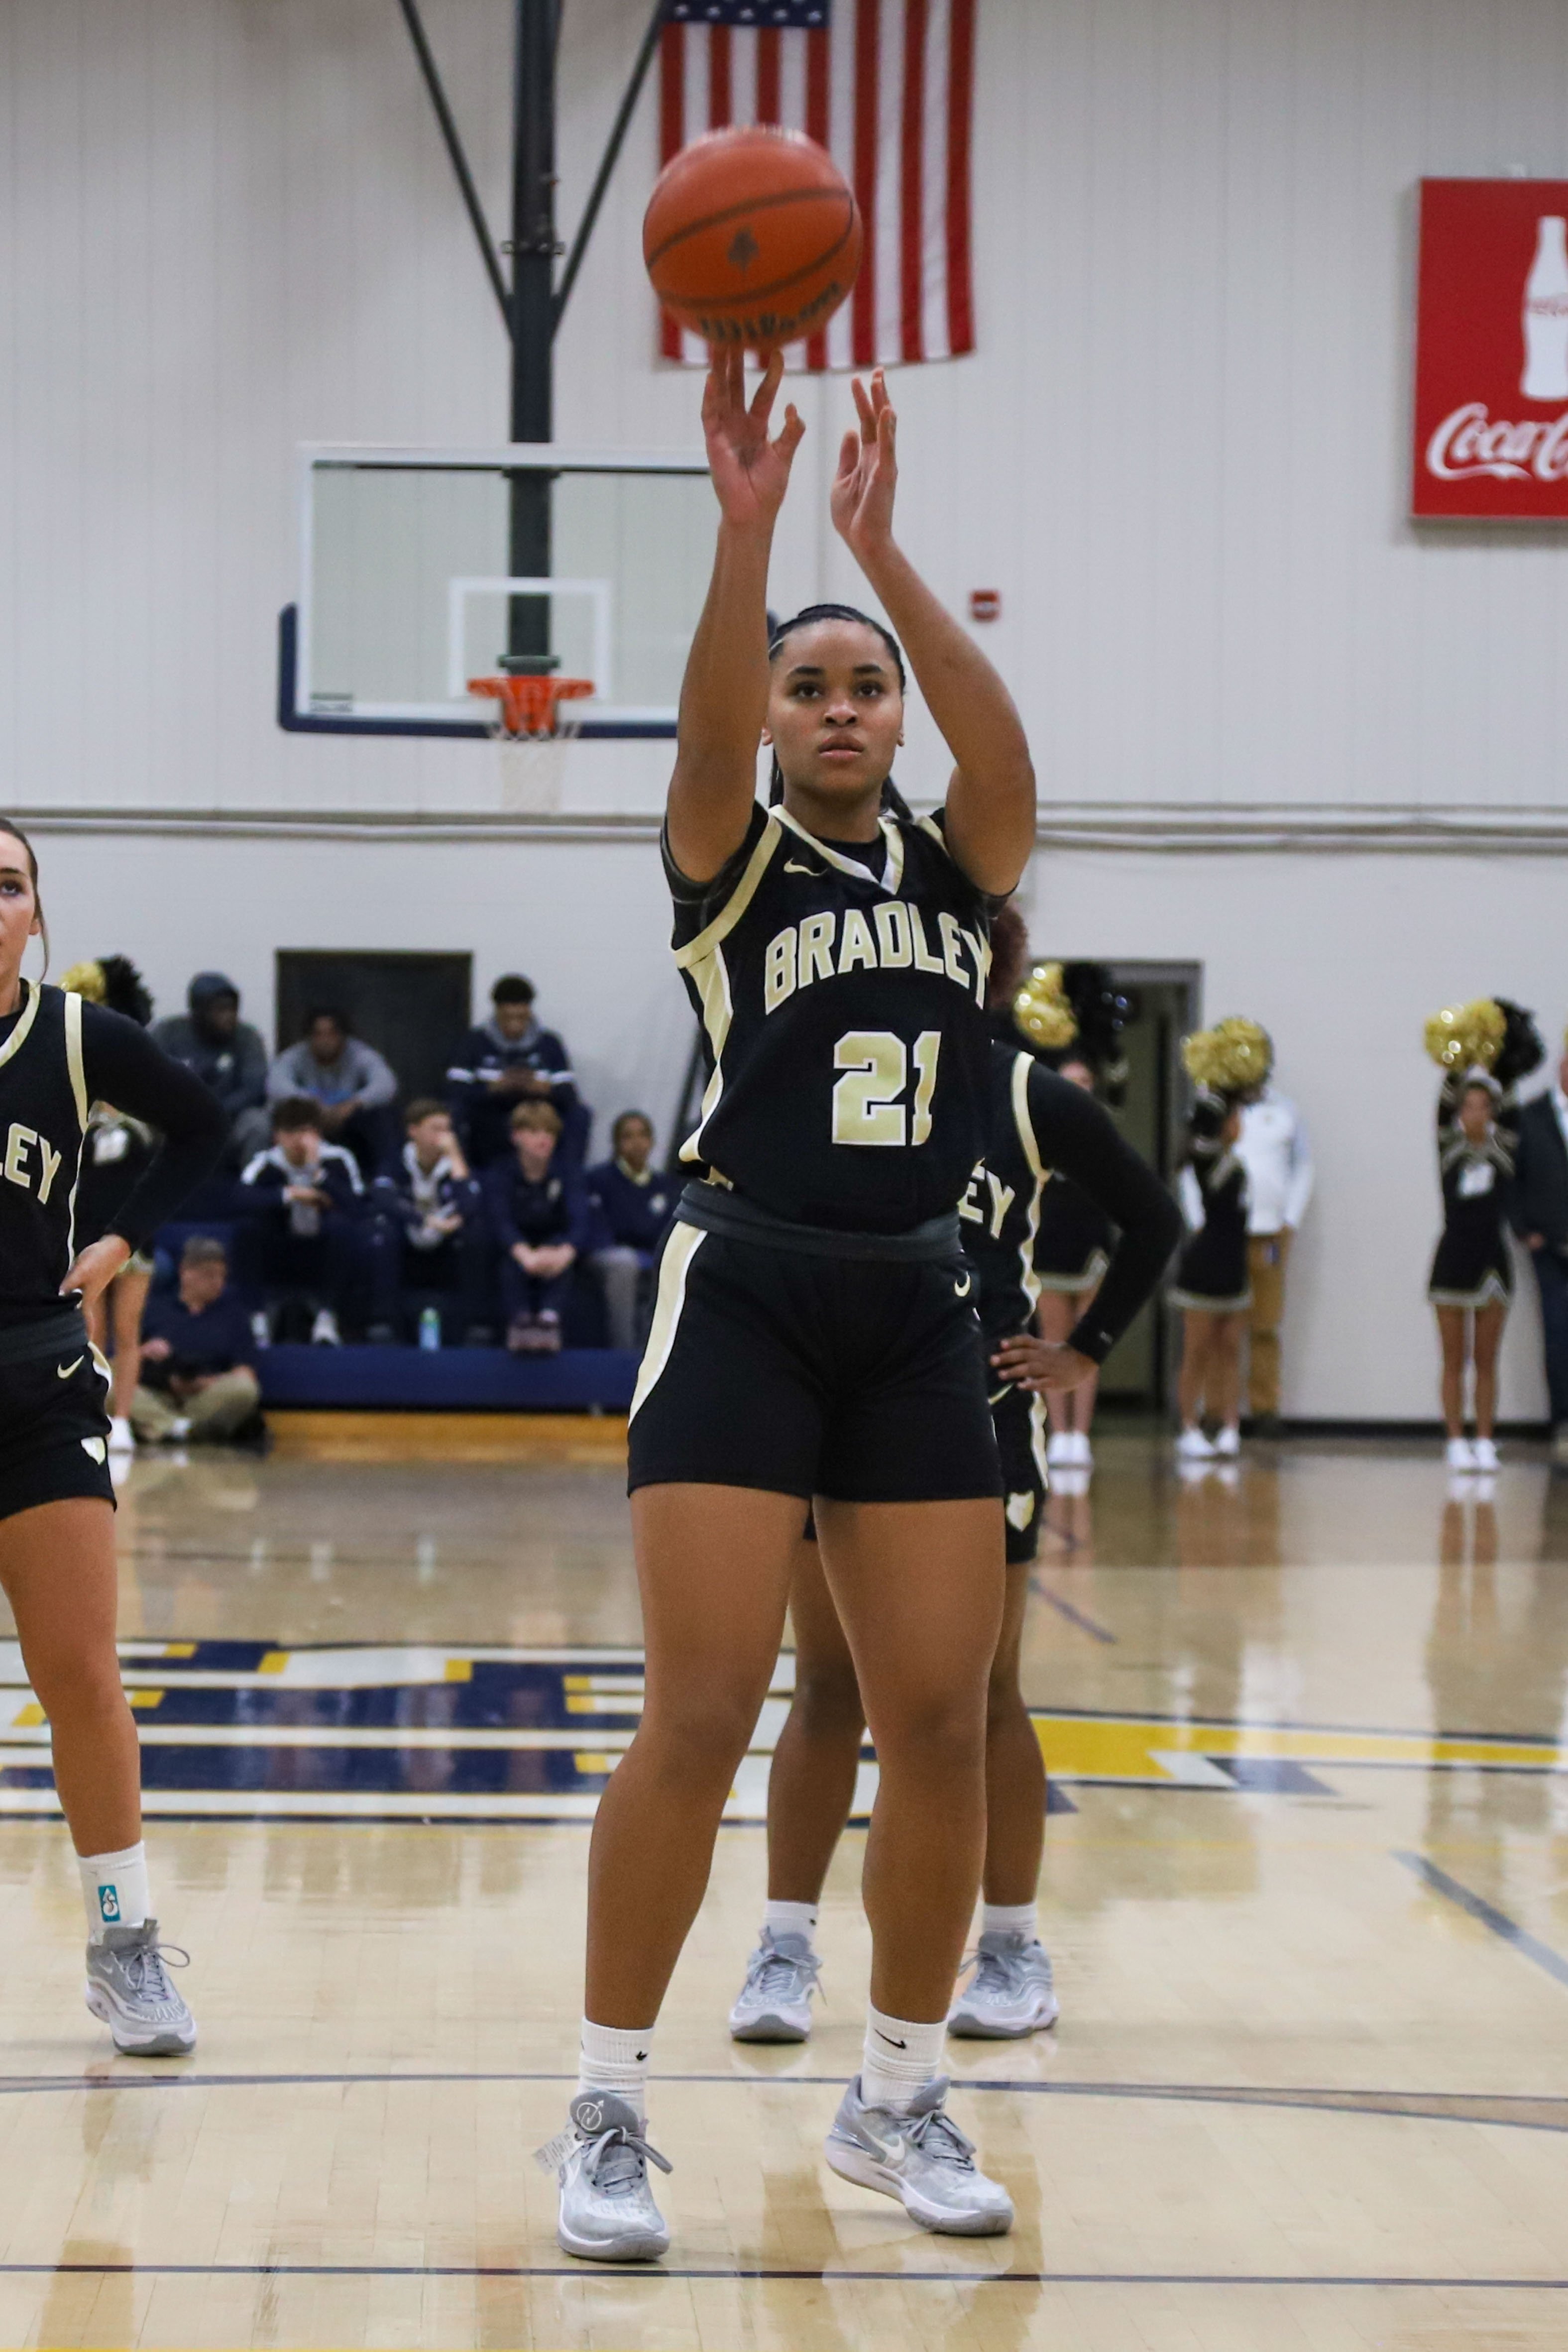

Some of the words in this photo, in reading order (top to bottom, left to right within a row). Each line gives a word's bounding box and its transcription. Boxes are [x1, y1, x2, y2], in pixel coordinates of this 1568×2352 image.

[764, 900, 993, 1015] BRADLEY
[832, 1030, 942, 1146] 21
[0, 1122, 62, 1205] EY
